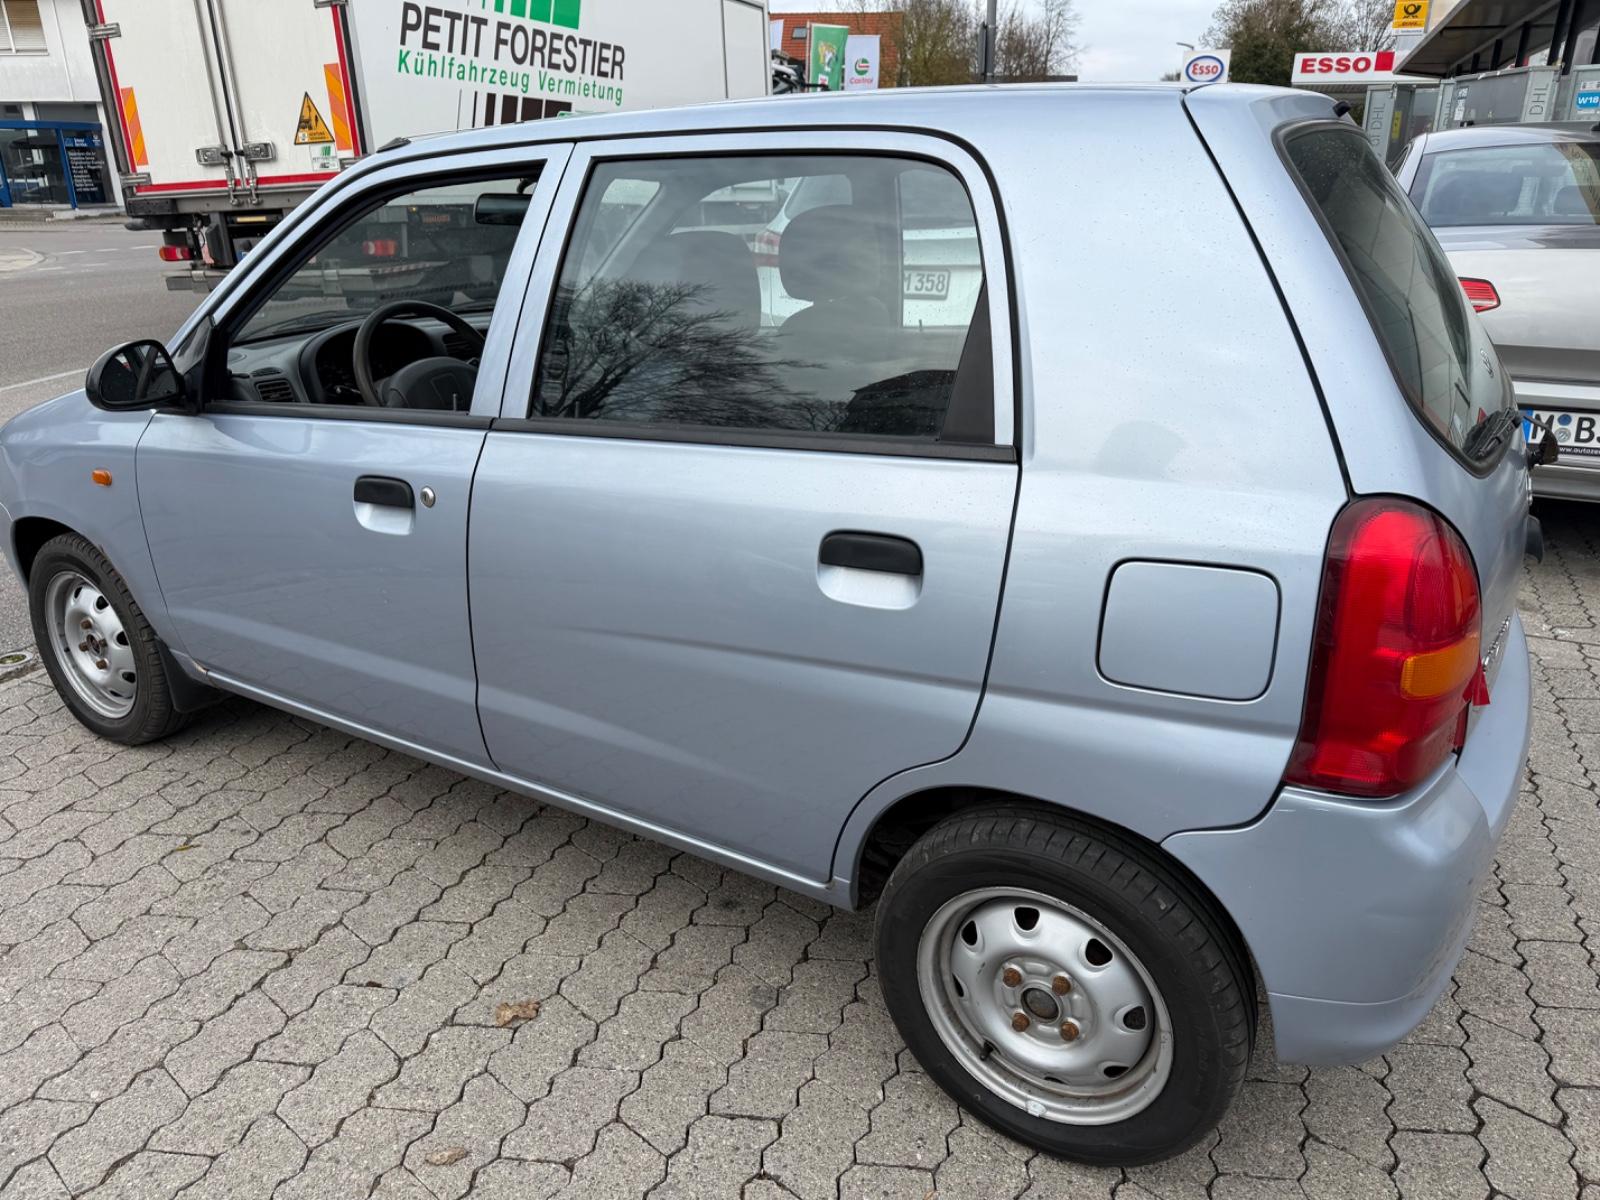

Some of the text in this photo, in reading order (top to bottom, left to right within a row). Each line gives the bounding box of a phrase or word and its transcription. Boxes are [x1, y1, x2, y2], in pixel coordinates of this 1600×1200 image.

[399, 1, 625, 81] PETIT FORESTIER
[398, 48, 623, 107] Kühlfahrzeug Vermietung
[1191, 63, 1220, 76] Esso
[1300, 57, 1372, 74] ESSO
[1527, 82, 1550, 115] DHL
[1578, 95, 1600, 104] W18
[1370, 102, 1386, 130] DHL
[914, 272, 946, 293] 358
